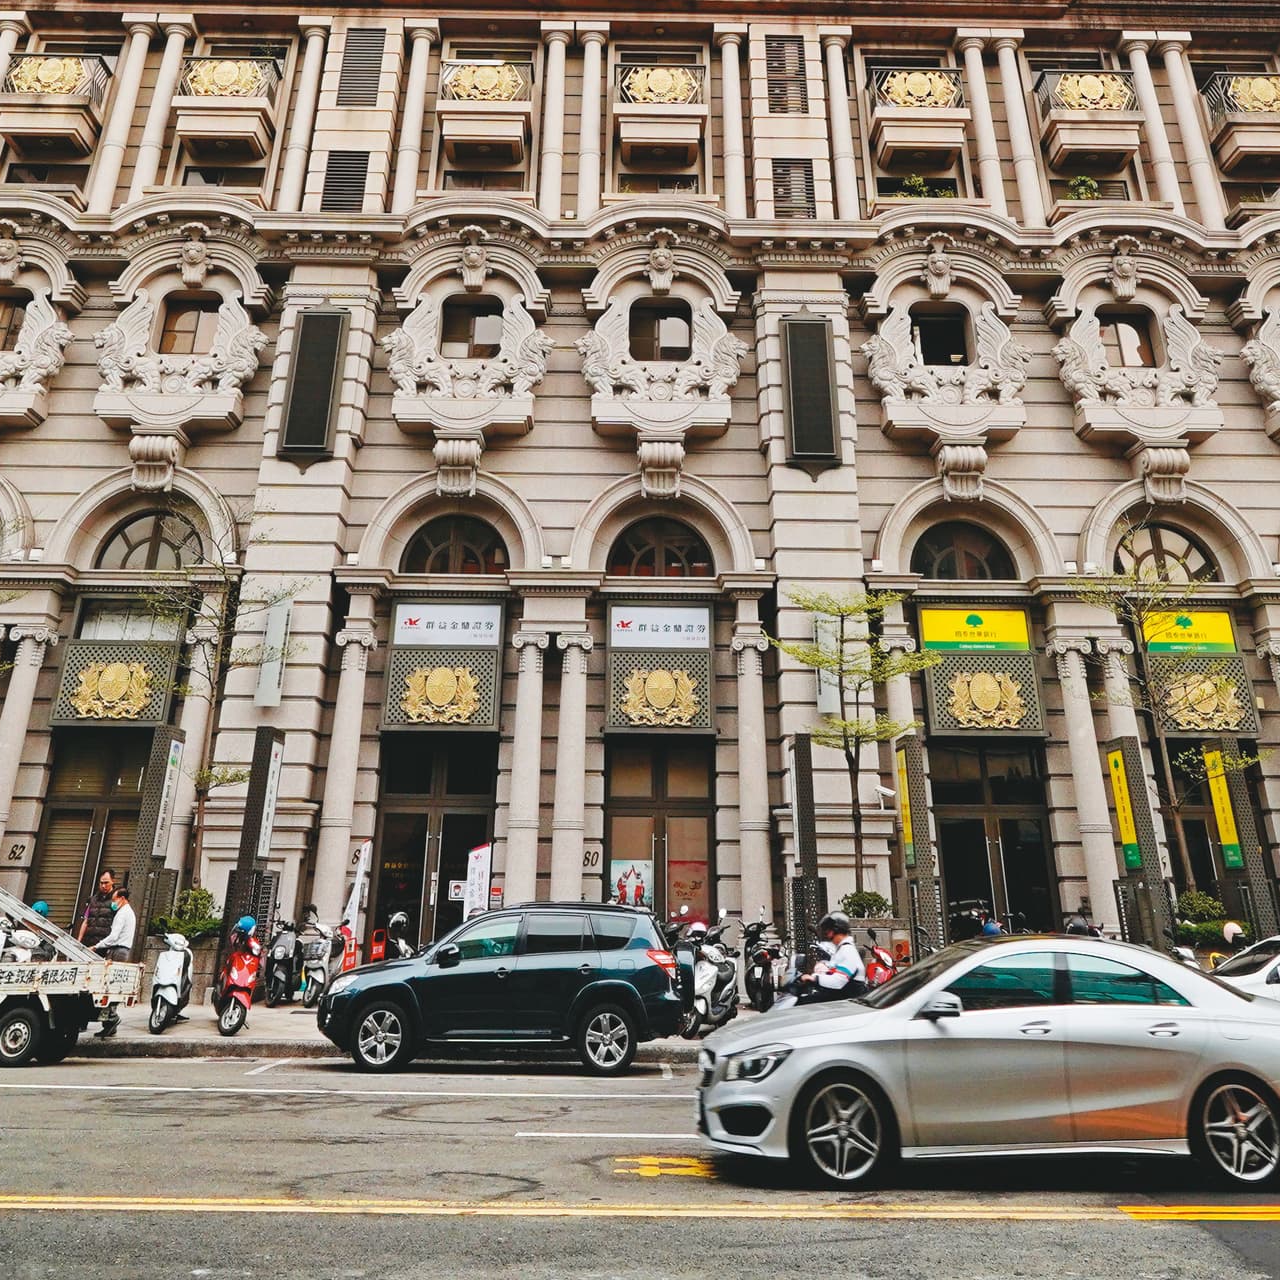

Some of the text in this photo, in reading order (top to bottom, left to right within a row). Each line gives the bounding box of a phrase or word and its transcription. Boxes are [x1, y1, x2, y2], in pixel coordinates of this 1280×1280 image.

[8, 845, 26, 860] 82
[352, 849, 361, 865] 8
[583, 851, 600, 867] 80
